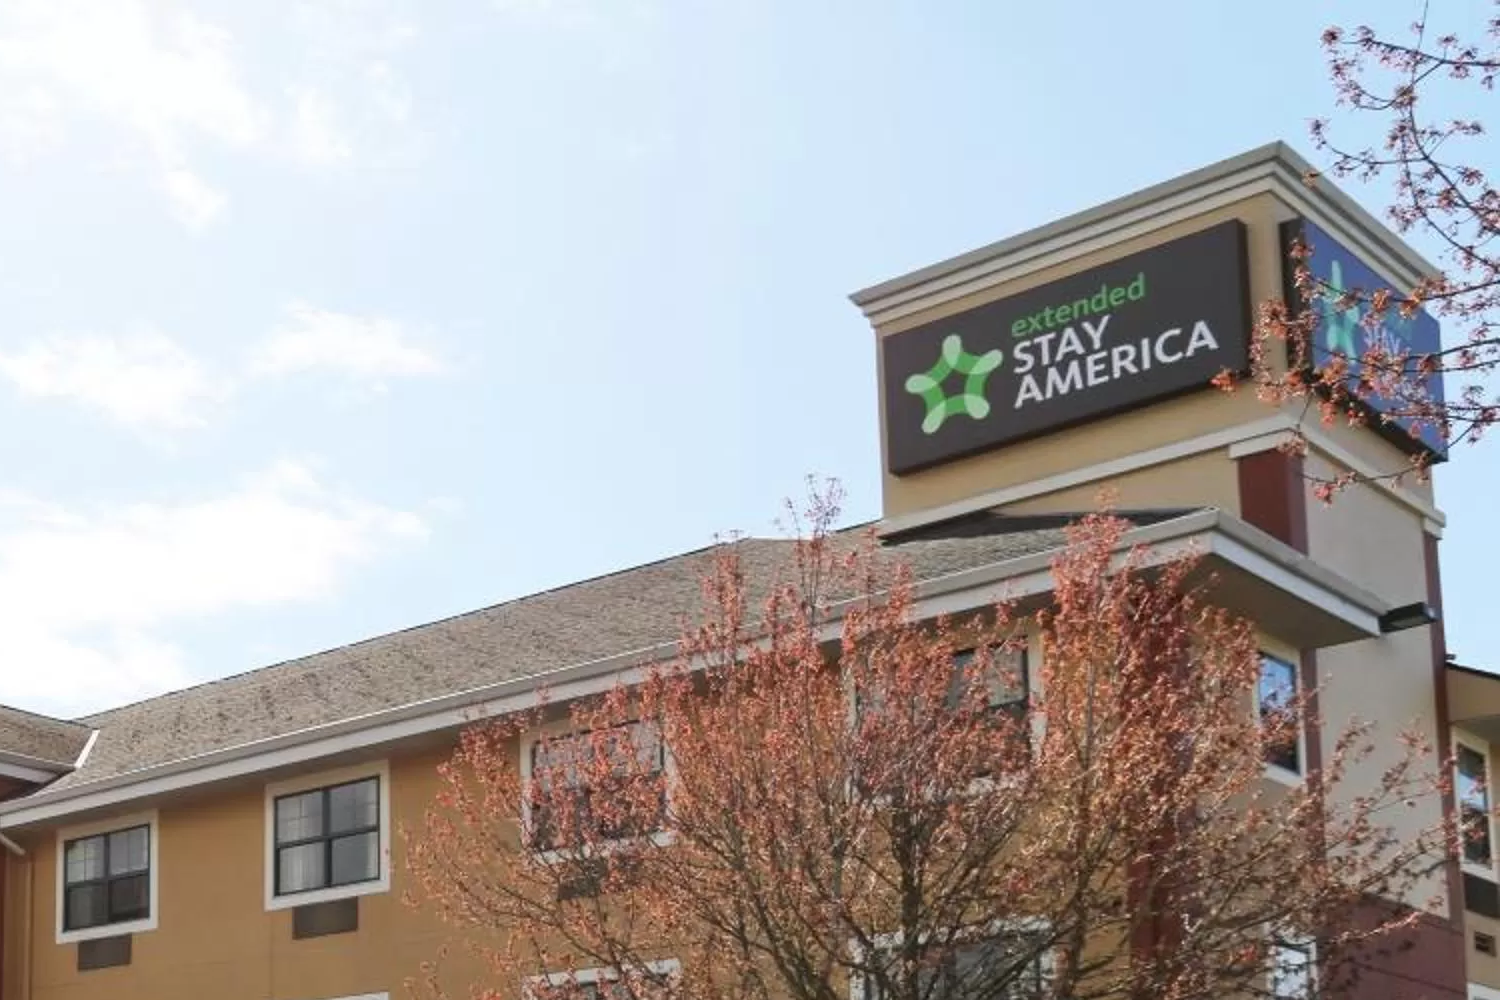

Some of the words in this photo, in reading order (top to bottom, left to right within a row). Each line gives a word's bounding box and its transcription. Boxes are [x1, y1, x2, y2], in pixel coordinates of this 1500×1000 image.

[1011, 272, 1146, 337] extended
[1013, 314, 1111, 373] STAY
[1014, 320, 1219, 409] AMERICA
